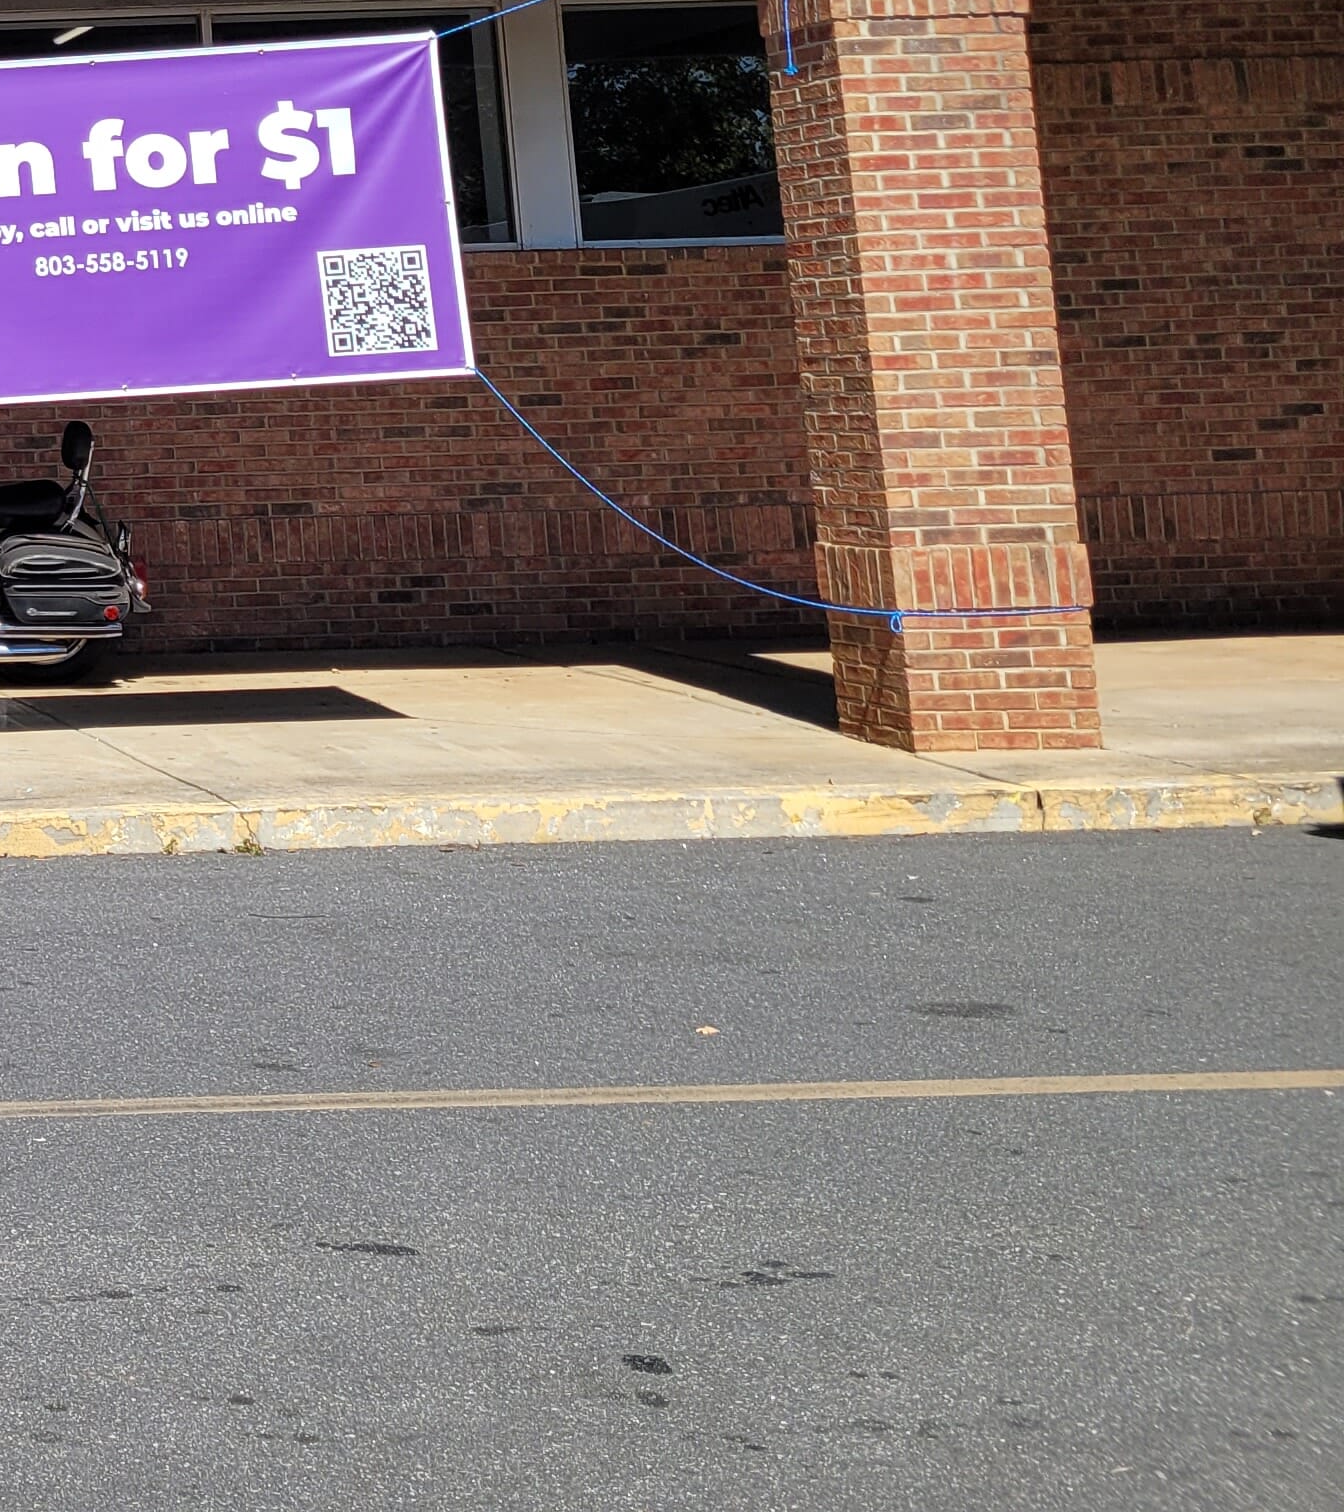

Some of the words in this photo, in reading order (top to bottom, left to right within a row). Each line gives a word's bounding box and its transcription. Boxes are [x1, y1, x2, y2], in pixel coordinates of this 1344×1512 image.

[82, 118, 230, 192] for
[258, 100, 356, 190] $1
[29, 216, 76, 239] call
[82, 218, 110, 235] or
[115, 208, 173, 233] visit
[178, 212, 210, 229] us
[215, 202, 298, 226] online
[35, 247, 188, 277] 803-558-5119
